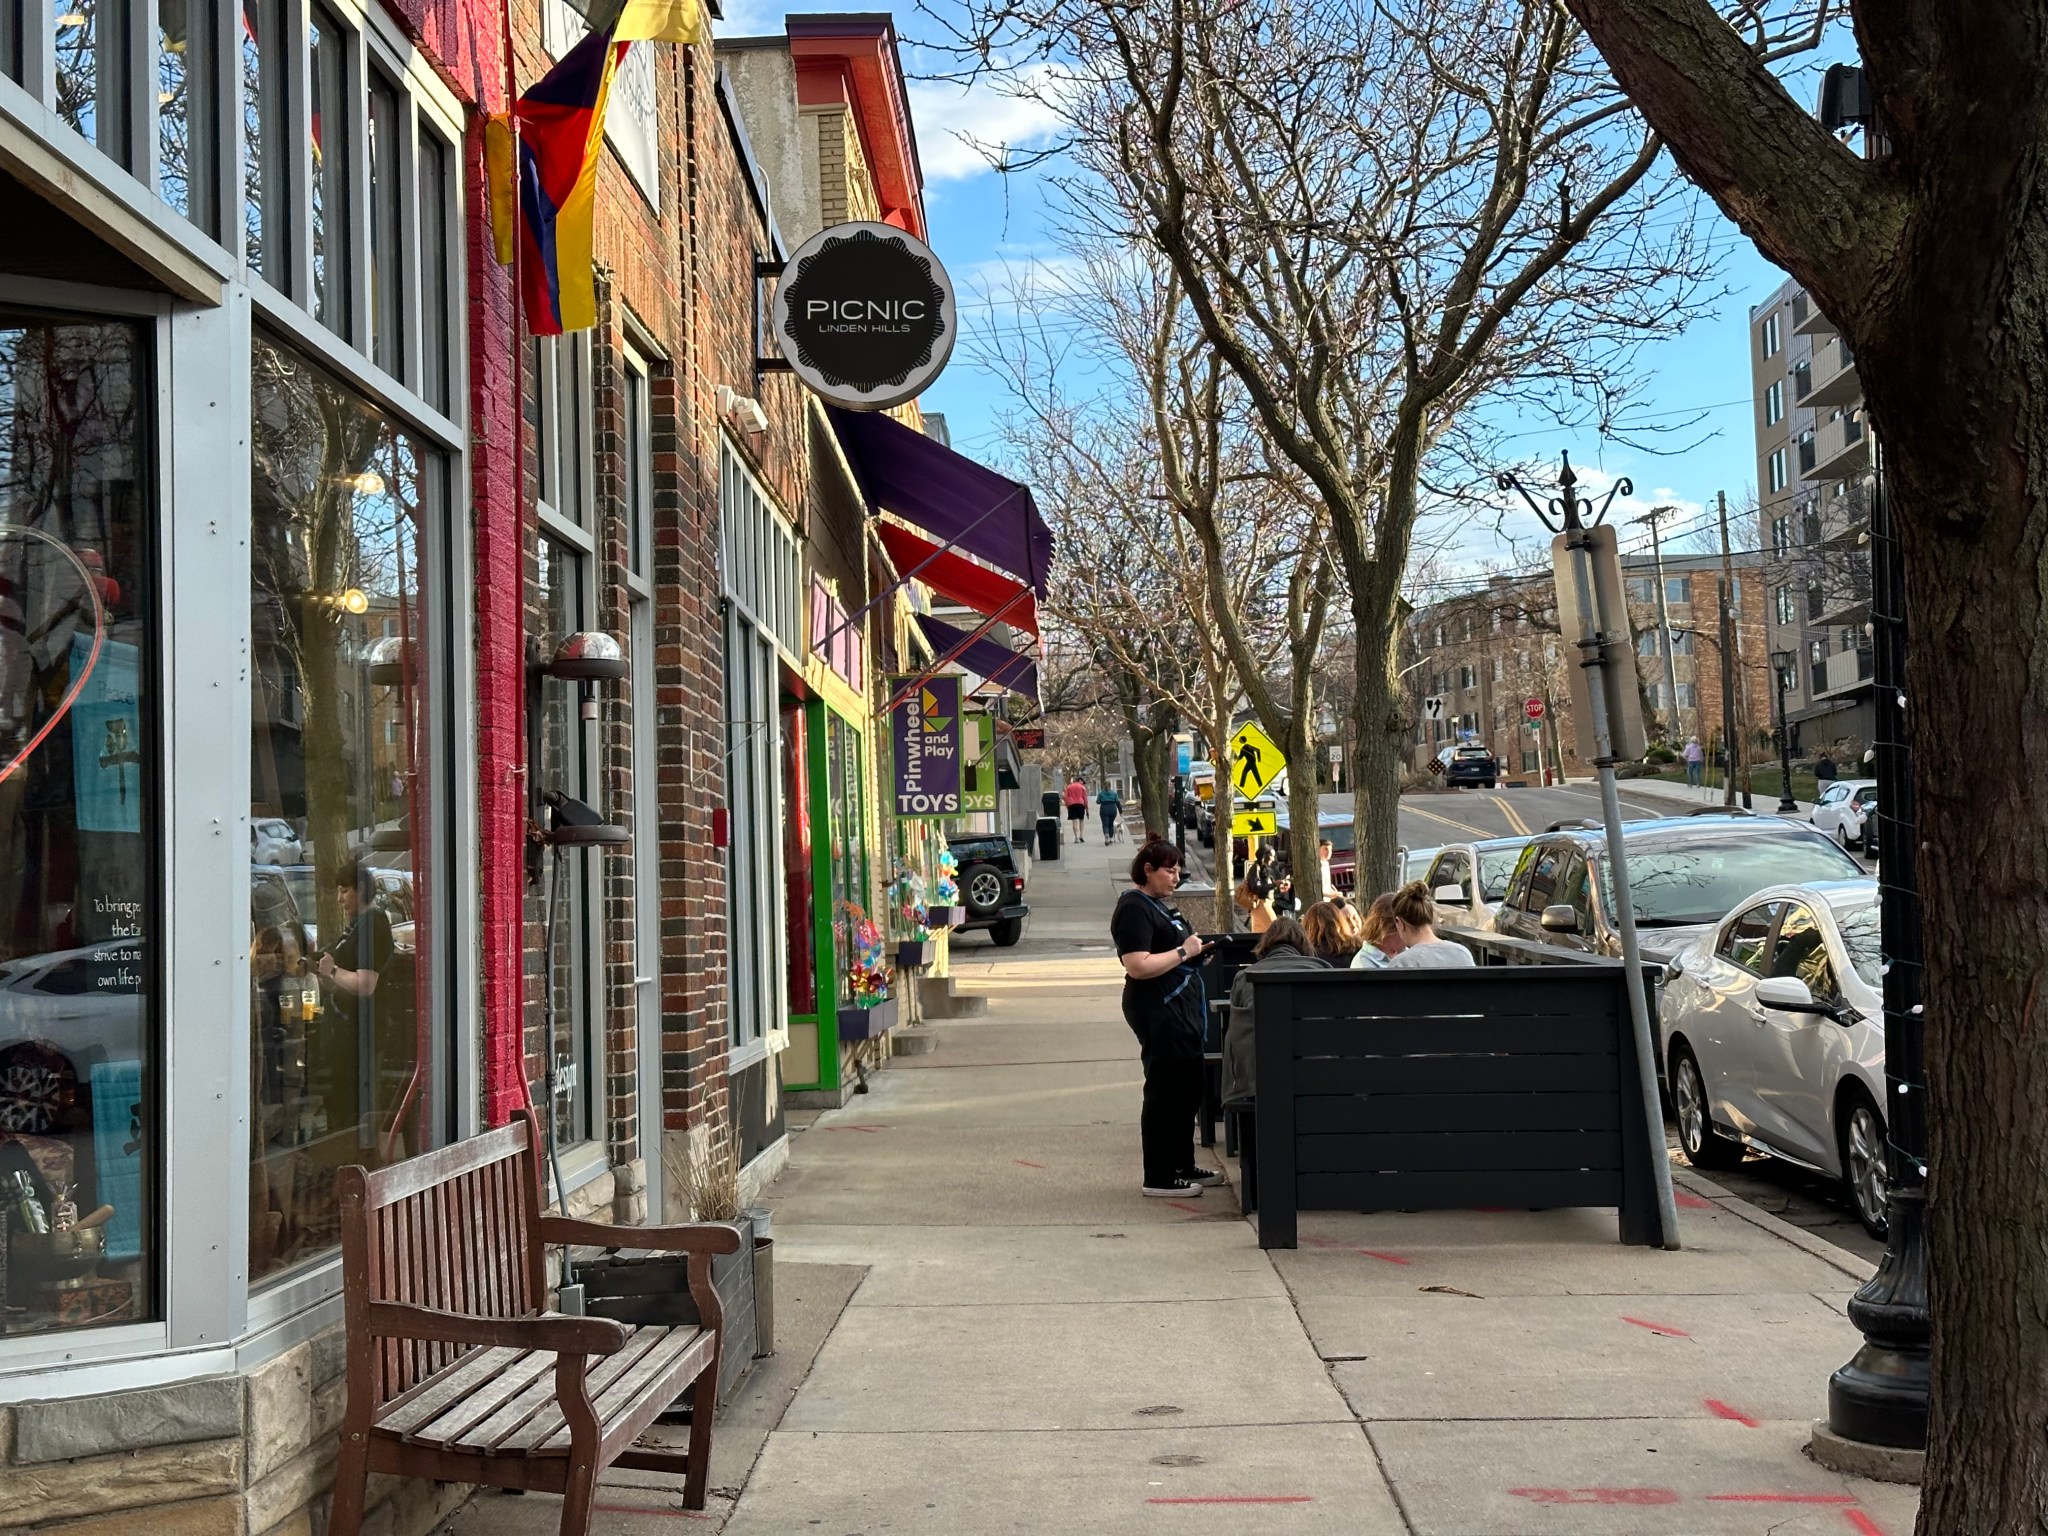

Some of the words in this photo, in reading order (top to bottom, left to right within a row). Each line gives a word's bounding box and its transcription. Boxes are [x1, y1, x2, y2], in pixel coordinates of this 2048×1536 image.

[807, 300, 925, 320] PICNIC
[818, 324, 867, 333] LINDEN
[871, 324, 911, 333] HILLS
[96, 680, 135, 705] Peace
[1526, 704, 1543, 713] STOP
[903, 686, 922, 792] Pinwheels
[925, 734, 949, 744] and
[925, 746, 954, 759] Play
[1331, 753, 1341, 761] 20
[898, 794, 958, 812] TOYS
[964, 794, 994, 808] OYS
[94, 898, 104, 912] To
[105, 894, 132, 918] bring
[112, 918, 130, 936] the
[94, 949, 118, 962] strive
[121, 948, 132, 960] to
[98, 976, 117, 987] own
[118, 967, 134, 985] life
